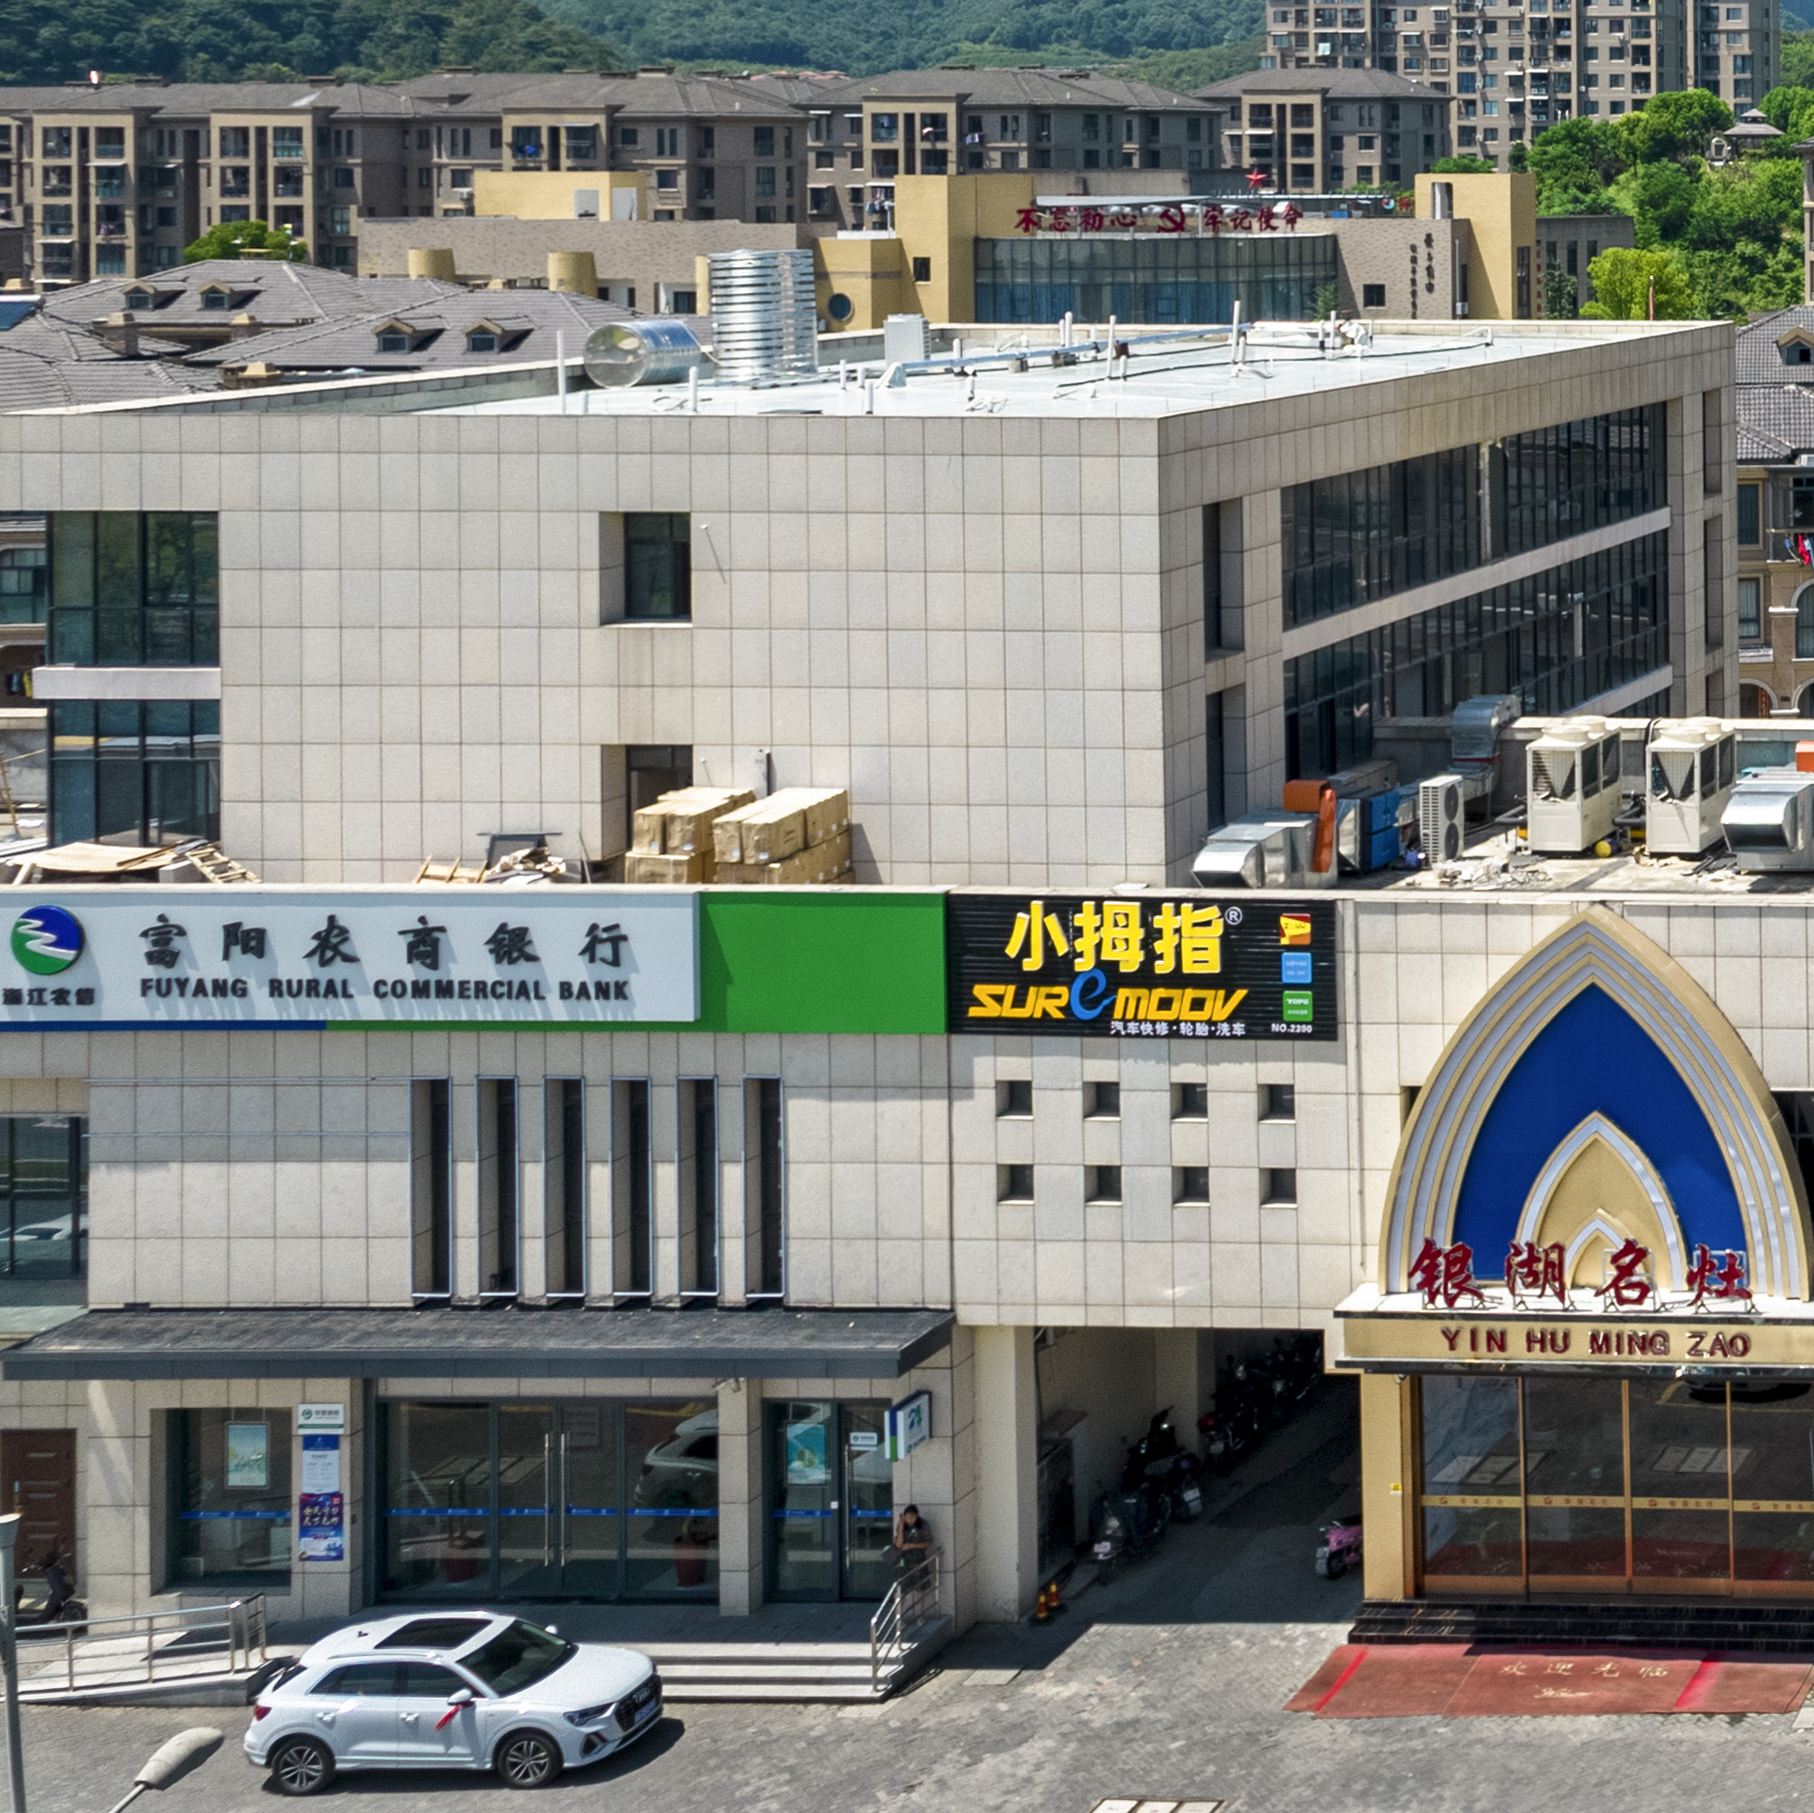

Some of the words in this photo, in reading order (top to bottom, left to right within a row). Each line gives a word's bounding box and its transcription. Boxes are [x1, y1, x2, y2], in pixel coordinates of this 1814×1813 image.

[1014, 207, 1138, 234] 不忘初心
[1202, 202, 1302, 234] 牢记使命
[139, 914, 628, 971] 富阳农商银行
[1005, 900, 1224, 973] 小拇指
[140, 977, 249, 999] FUYANG
[269, 977, 354, 999] RURAL
[373, 978, 546, 1001] COMMERCIAL
[558, 979, 629, 1001] BANK
[1408, 1238, 1753, 1306] 银湖名灶
[1441, 1327, 1506, 1353] YIN
[1526, 1328, 1570, 1354] HU
[1589, 1329, 1670, 1356] MING
[1686, 1331, 1751, 1357] ZAO
